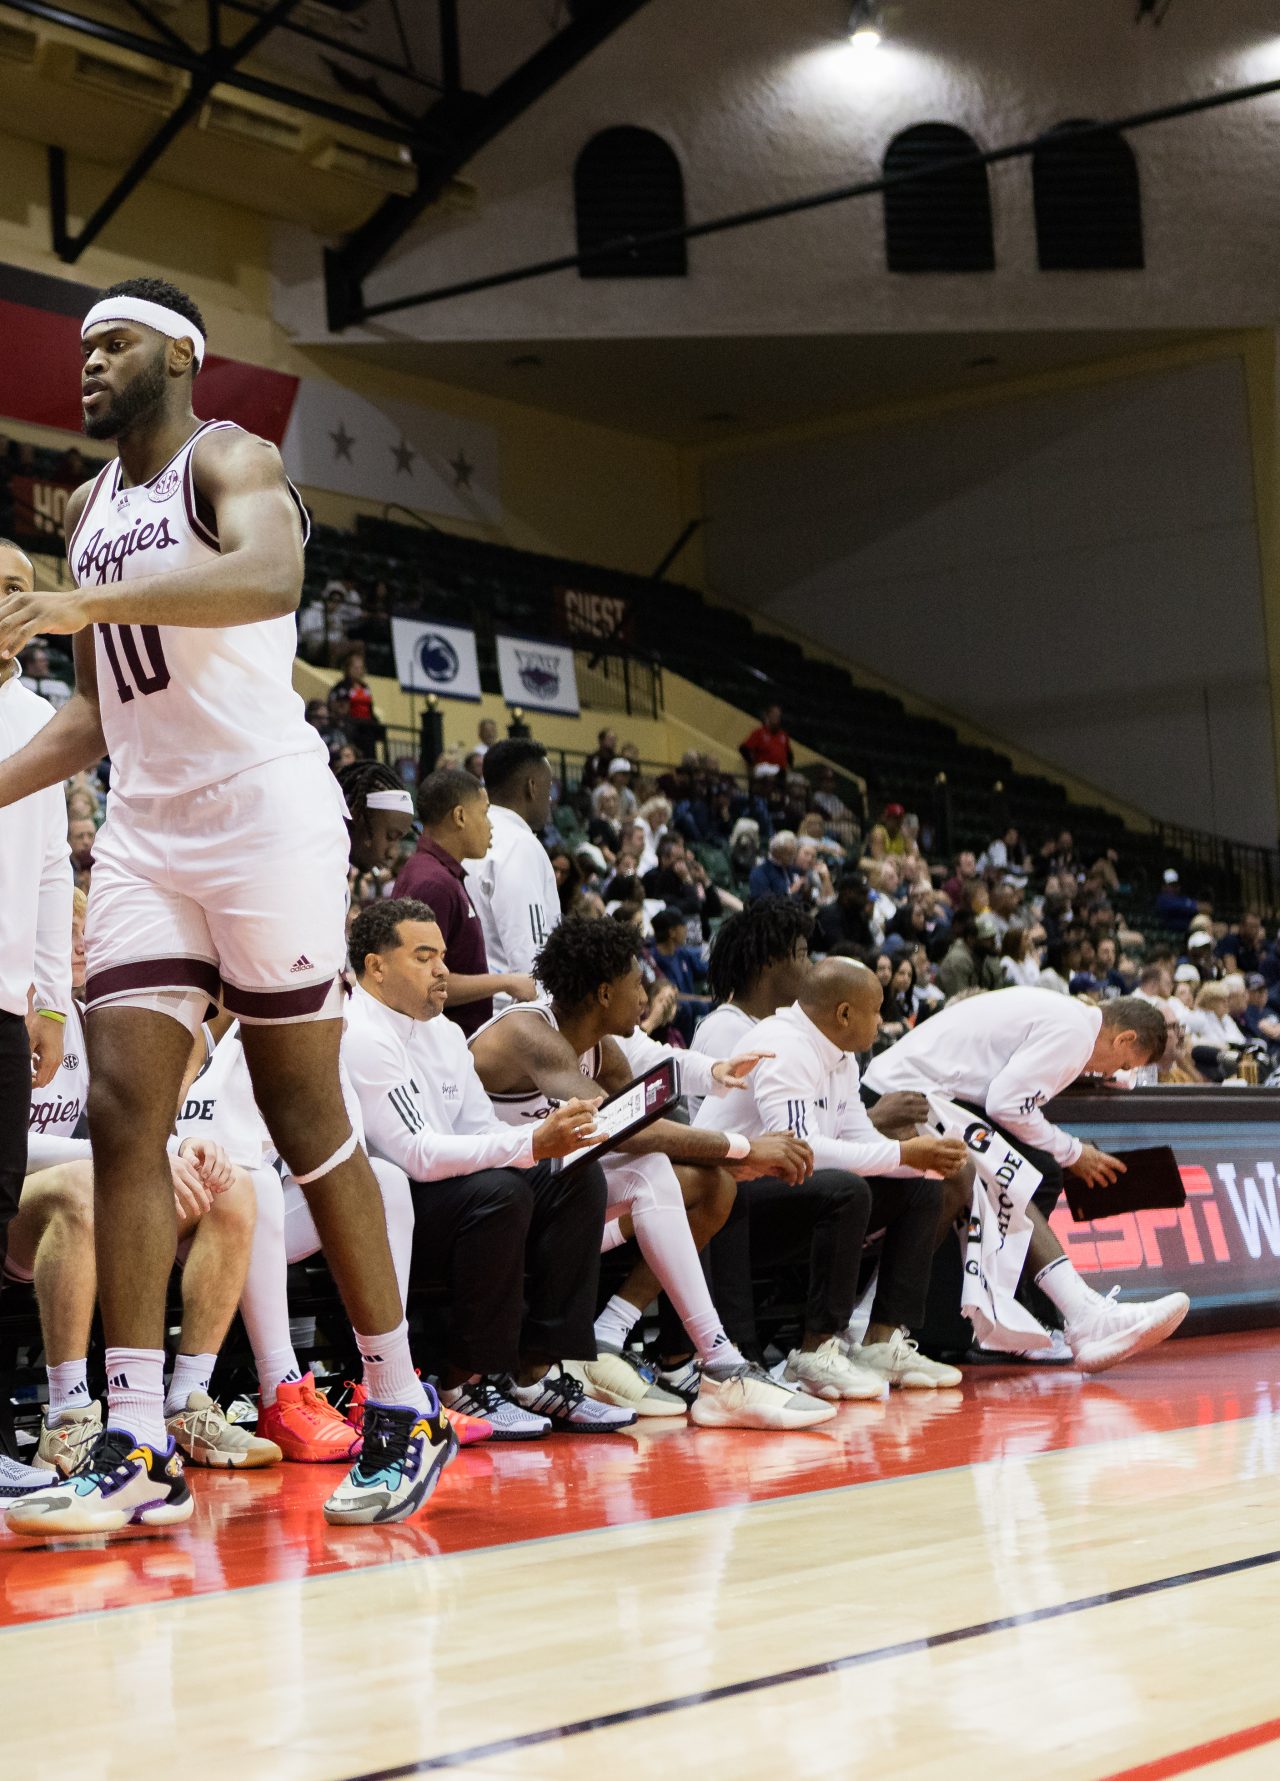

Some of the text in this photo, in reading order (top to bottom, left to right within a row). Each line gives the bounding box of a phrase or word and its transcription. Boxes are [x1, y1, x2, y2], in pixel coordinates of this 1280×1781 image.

[78, 517, 180, 587] Aggies
[98, 623, 171, 704] 10
[290, 964, 314, 973] adidas
[64, 1056, 78, 1069] SEC
[177, 1099, 217, 1121] DE
